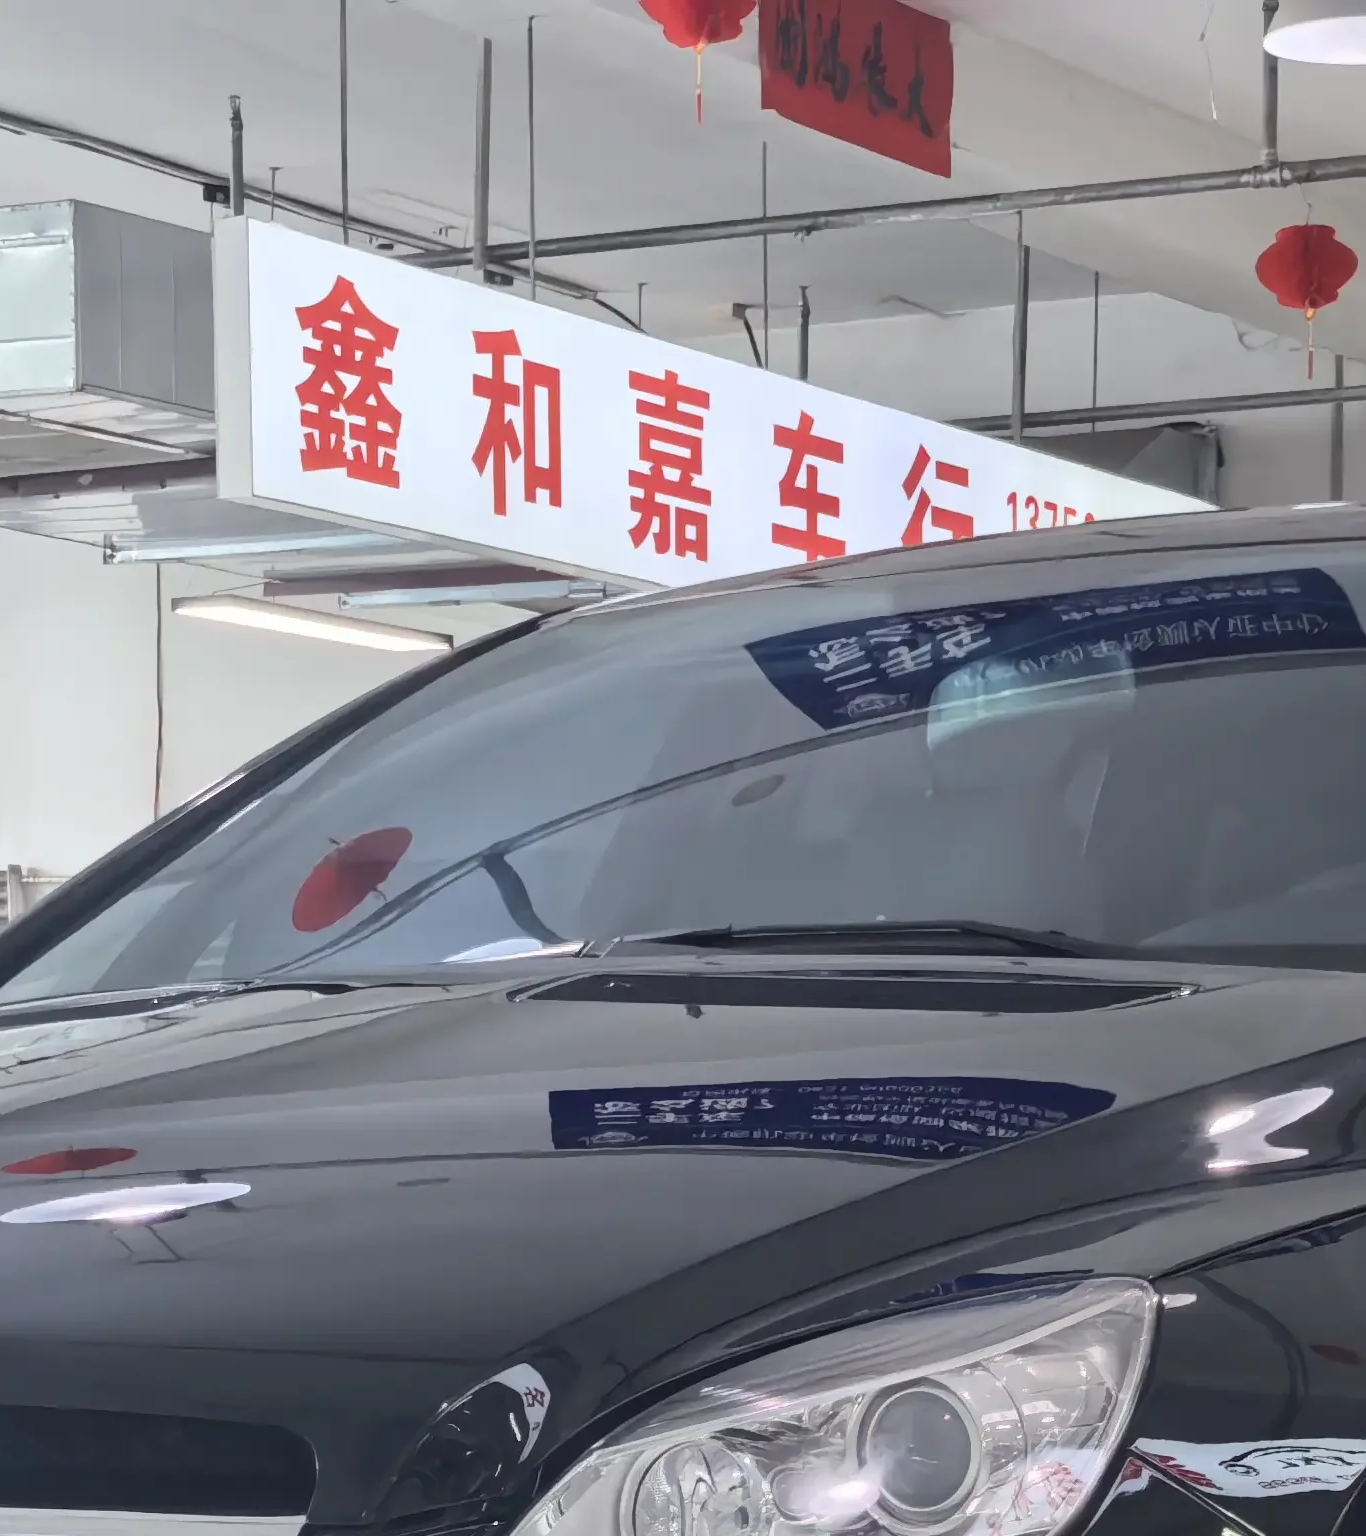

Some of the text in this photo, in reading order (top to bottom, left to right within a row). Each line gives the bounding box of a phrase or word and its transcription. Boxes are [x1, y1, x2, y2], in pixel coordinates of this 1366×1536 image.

[295, 275, 974, 561] 鑫和嘉车行
